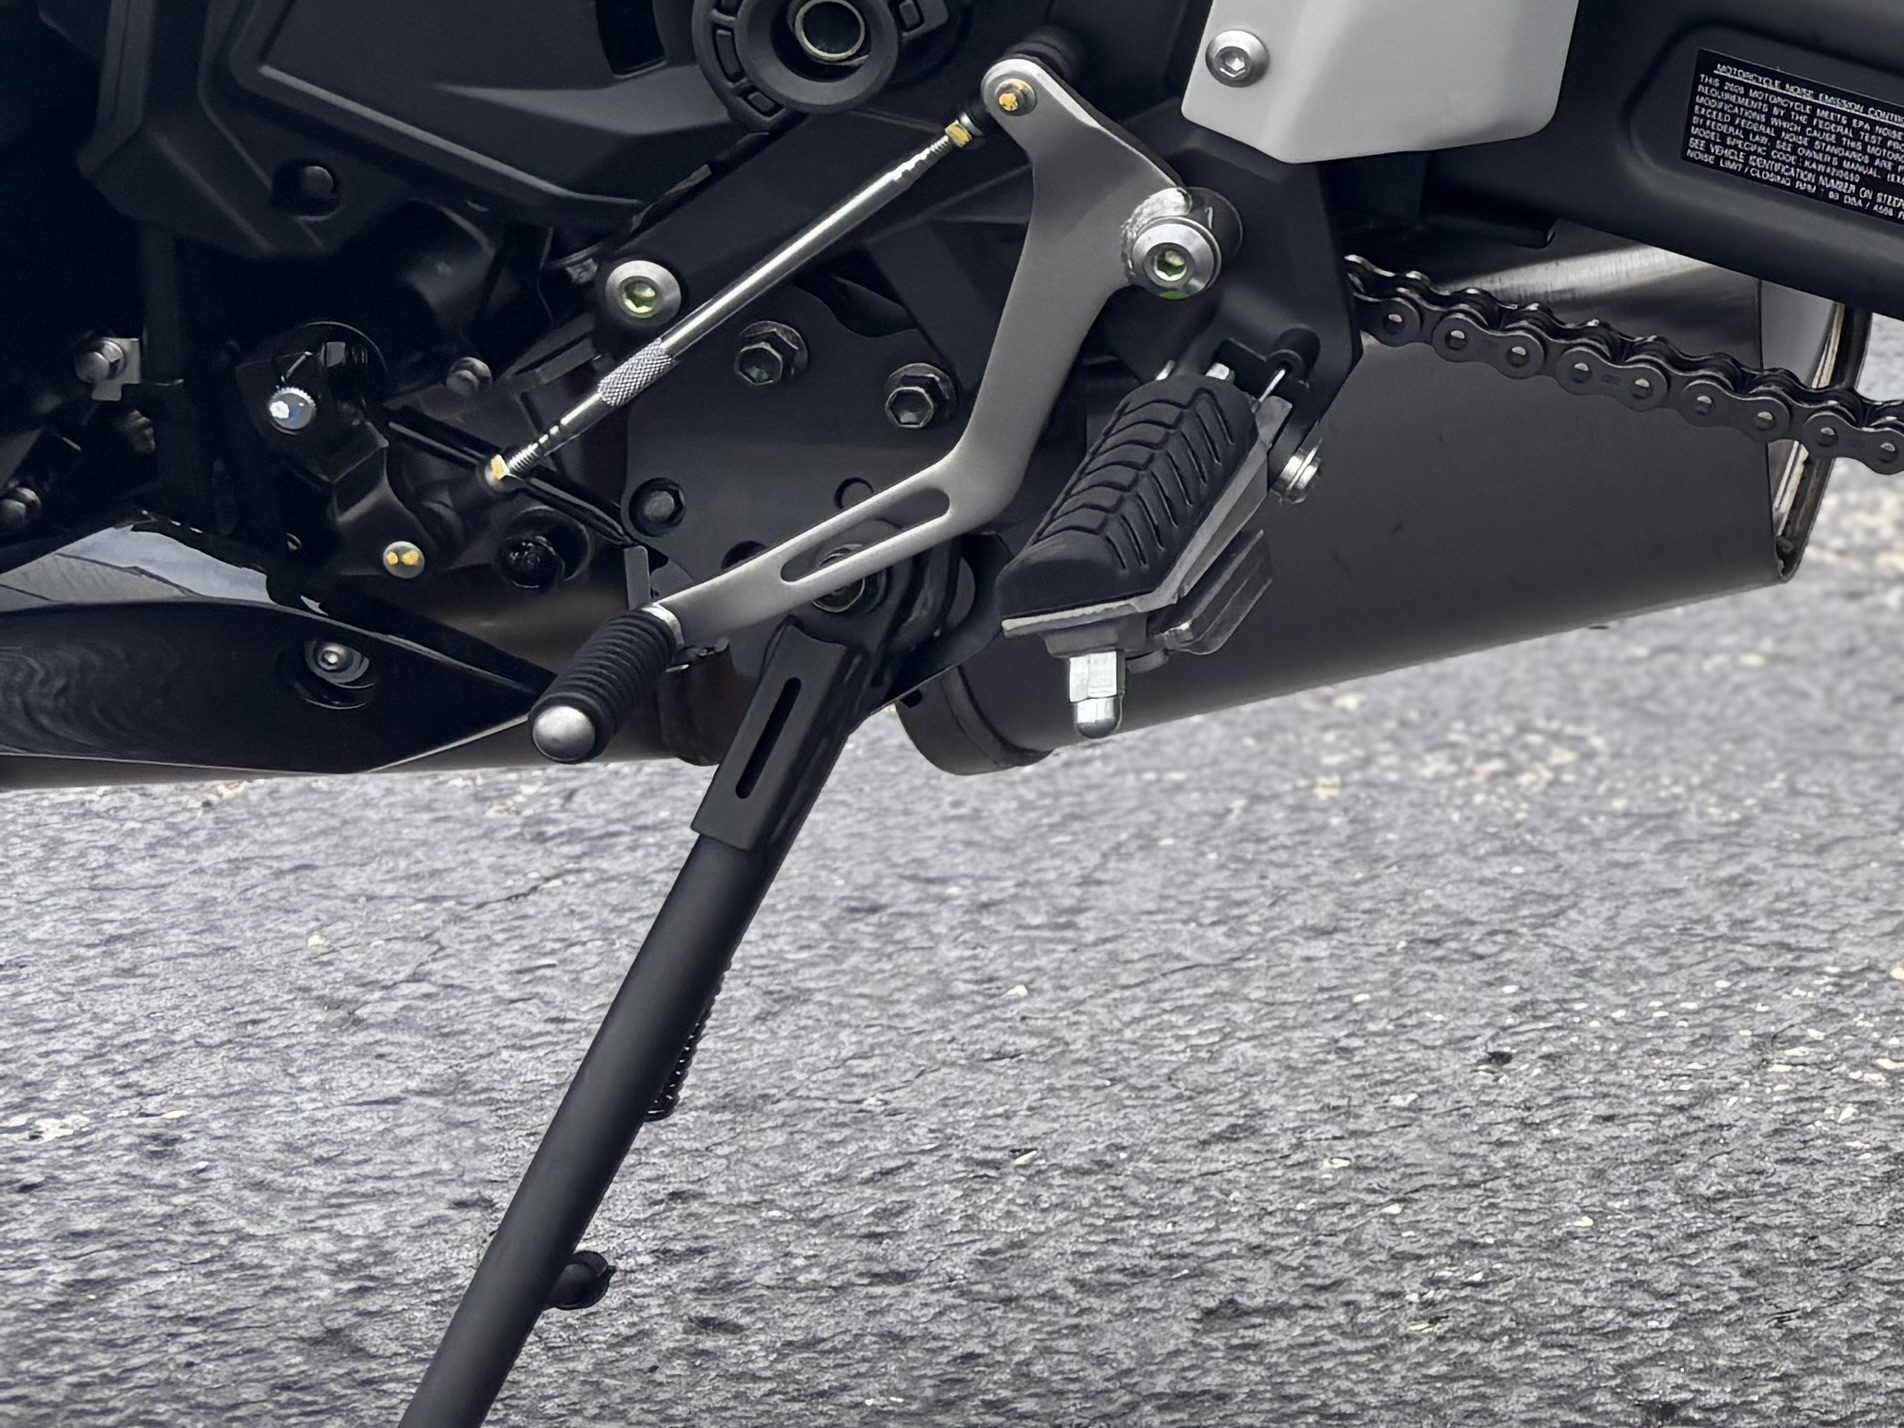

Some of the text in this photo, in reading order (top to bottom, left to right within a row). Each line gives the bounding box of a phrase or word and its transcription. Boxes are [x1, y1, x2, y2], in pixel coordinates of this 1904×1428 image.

[1697, 83, 1768, 112] REQUIREMENTS
[1772, 105, 1785, 117] BY
[1790, 111, 1808, 124] THE
[1812, 117, 1854, 137] FEDERAL
[1858, 131, 1881, 145] TEST
[1699, 73, 1720, 87] THIS
[1748, 88, 1811, 114] MOTORCYCLE
[1816, 107, 1847, 124] MEETS
[1851, 118, 1870, 131] EPA
[1874, 125, 1903, 141] NOISE
[1716, 62, 1780, 88] MOTORCYCLE
[1785, 82, 1813, 98] NOISE
[1818, 92, 1863, 112] EMISSION
[1690, 125, 1721, 142] MODEL
[1726, 135, 1766, 155] SPECIFIC
[1692, 115, 1703, 126] BY
[1705, 119, 1744, 138] FEDERAL
[1775, 139, 1792, 152] SEE
[1694, 104, 1730, 123] EXCEED
[1734, 116, 1776, 136] FEDERAL
[1781, 130, 1809, 146] NOISE
[1814, 140, 1869, 164] STANDARDS
[1874, 157, 1893, 171] ARE
[1695, 94, 1766, 122] MODIFICATIONS
[1769, 116, 1801, 133] WHICH
[1805, 126, 1836, 143] CAUSE
[1841, 137, 1862, 151] THIS
[1686, 148, 1714, 164] NOISE
[1688, 136, 1706, 151] SEE
[1708, 142, 1745, 163] VEHICLE
[1748, 154, 1815, 183] IDENTIFICATION
[1818, 174, 1856, 195] NUMBER
[1858, 186, 1873, 200] ON
